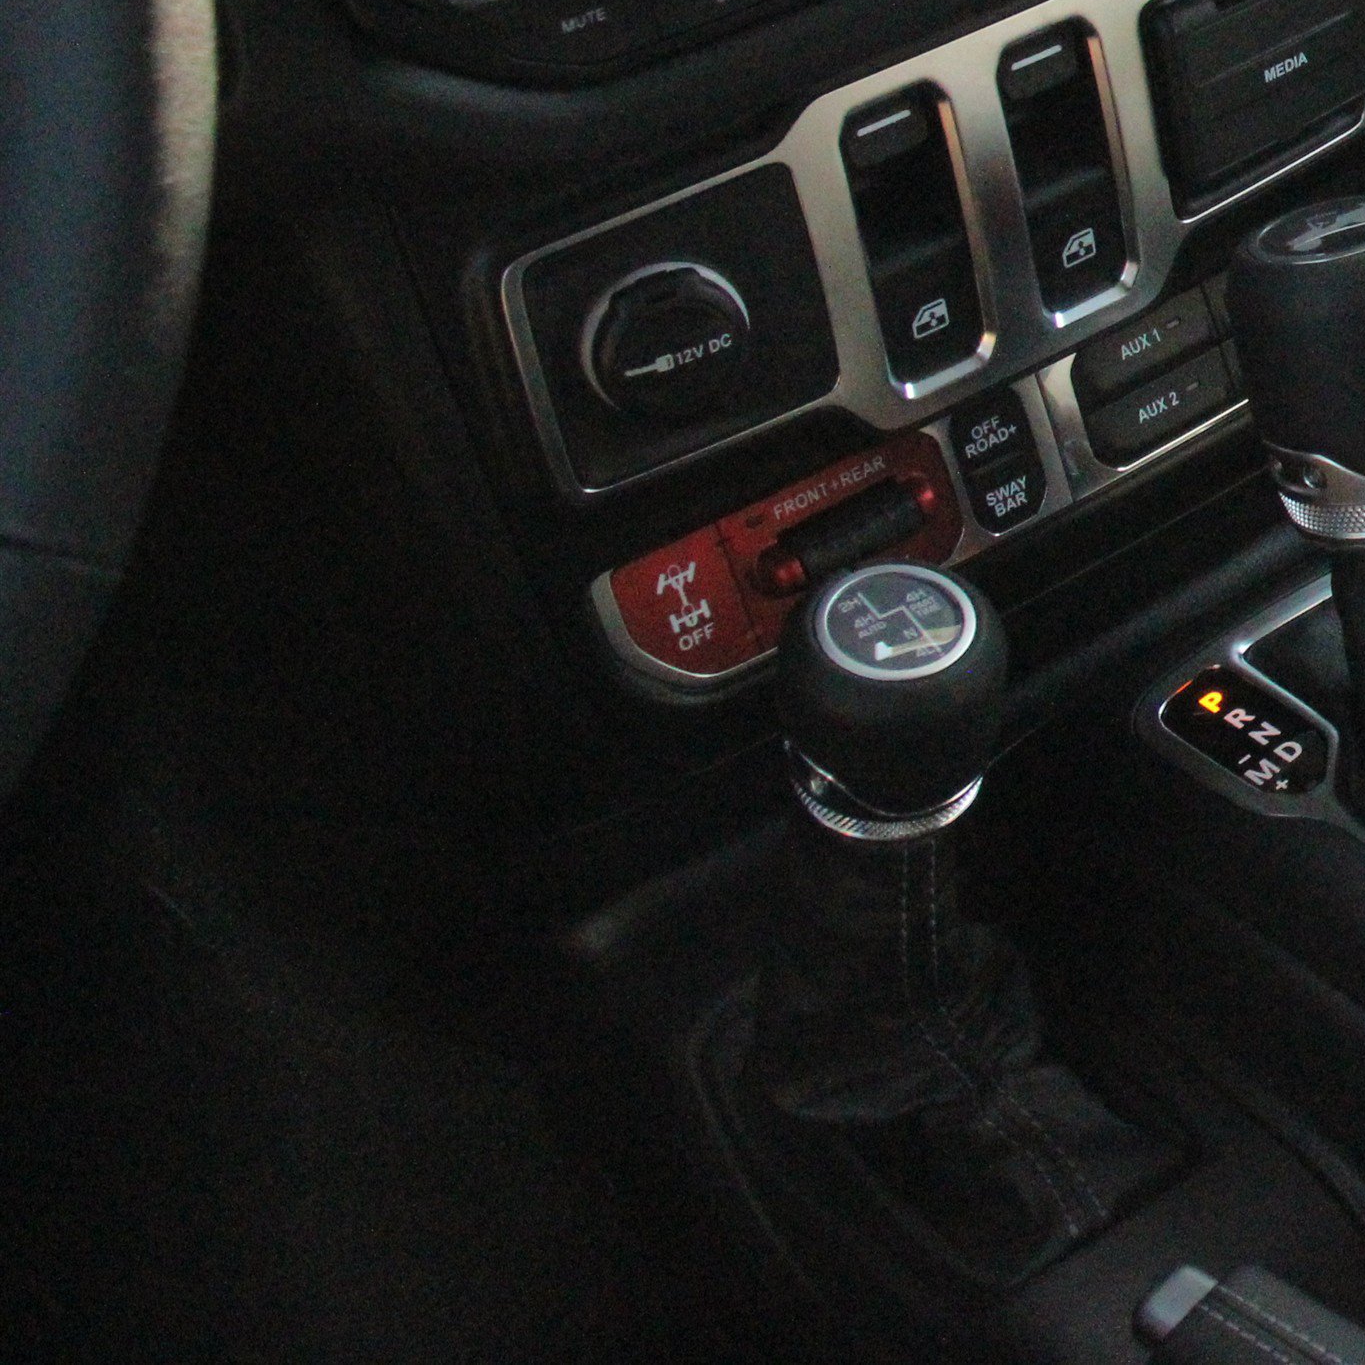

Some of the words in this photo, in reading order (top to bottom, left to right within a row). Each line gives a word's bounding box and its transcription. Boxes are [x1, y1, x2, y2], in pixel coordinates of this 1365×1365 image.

[561, 7, 607, 34] MUTE
[1263, 51, 1309, 84] MEDIA
[676, 344, 704, 365] 12V
[708, 333, 732, 354] DC
[1120, 333, 1151, 361] AUX
[1138, 396, 1169, 425] AUX
[1168, 391, 1180, 407] 2
[971, 416, 1000, 439] OFF
[986, 475, 1027, 507] SWAY
[994, 491, 1028, 517] BAR
[678, 621, 715, 651] OFF
[1198, 691, 1223, 714] P
[1223, 708, 1256, 729] R
[1248, 721, 1282, 746] N
[1273, 741, 1303, 763] D
[1244, 758, 1281, 785] M
